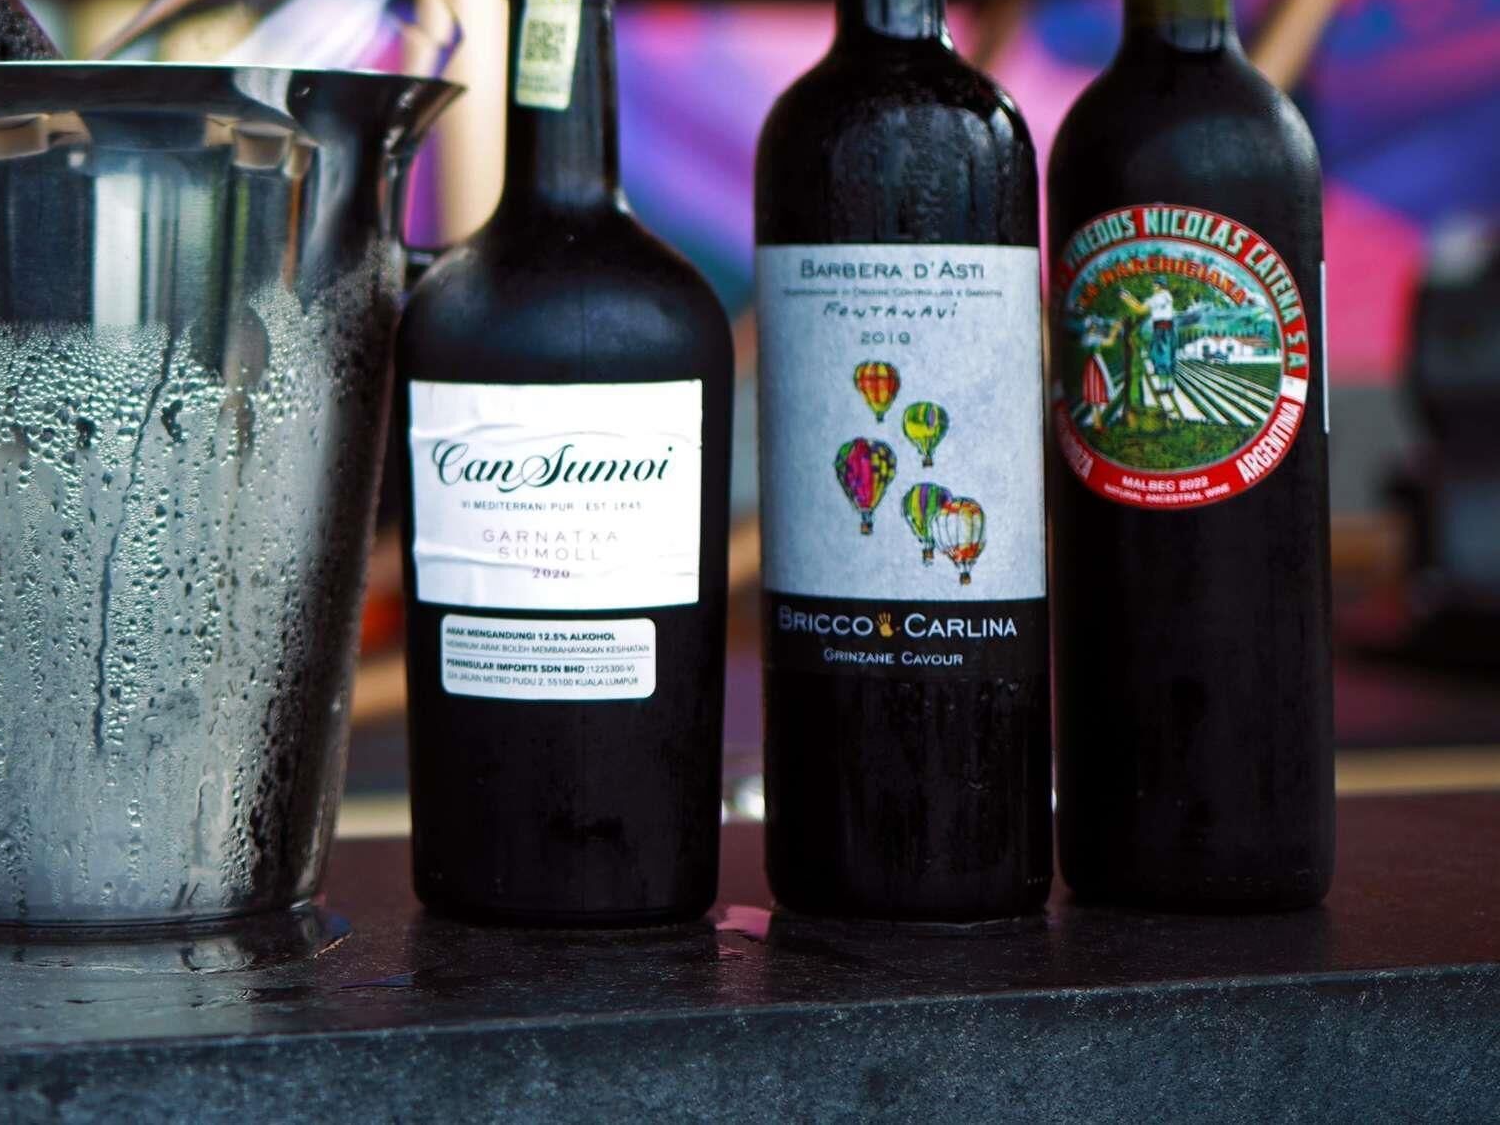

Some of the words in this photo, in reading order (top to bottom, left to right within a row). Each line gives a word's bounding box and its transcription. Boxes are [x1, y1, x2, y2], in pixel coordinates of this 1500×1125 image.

[801, 259, 903, 280] BARBERA
[1143, 207, 1251, 254] NICOLAS
[1245, 243, 1301, 323] CATENA
[1236, 401, 1300, 484] ARGENTINA
[432, 440, 515, 487] Can
[497, 444, 673, 493] Sumoi
[1122, 475, 1175, 492] MALBEC
[461, 501, 471, 510] VI
[473, 501, 546, 511] MEDITERRANI
[550, 502, 574, 511] PUR
[482, 528, 618, 544] GARNATXA
[498, 546, 601, 562] SUMOLL
[779, 605, 874, 636] BRICCO
[904, 613, 1018, 638] CARLINA
[467, 629, 536, 640] MENGANDUNGI
[539, 632, 568, 641] 12.5%
[569, 632, 616, 641] ALKOHOL
[824, 648, 895, 664] GRINZANE
[901, 651, 964, 666] CAVOUR
[446, 659, 494, 670] PENINSULAR
[496, 663, 538, 672] IMPORTS
[541, 664, 561, 673] SDN
[564, 664, 585, 674] BHD
